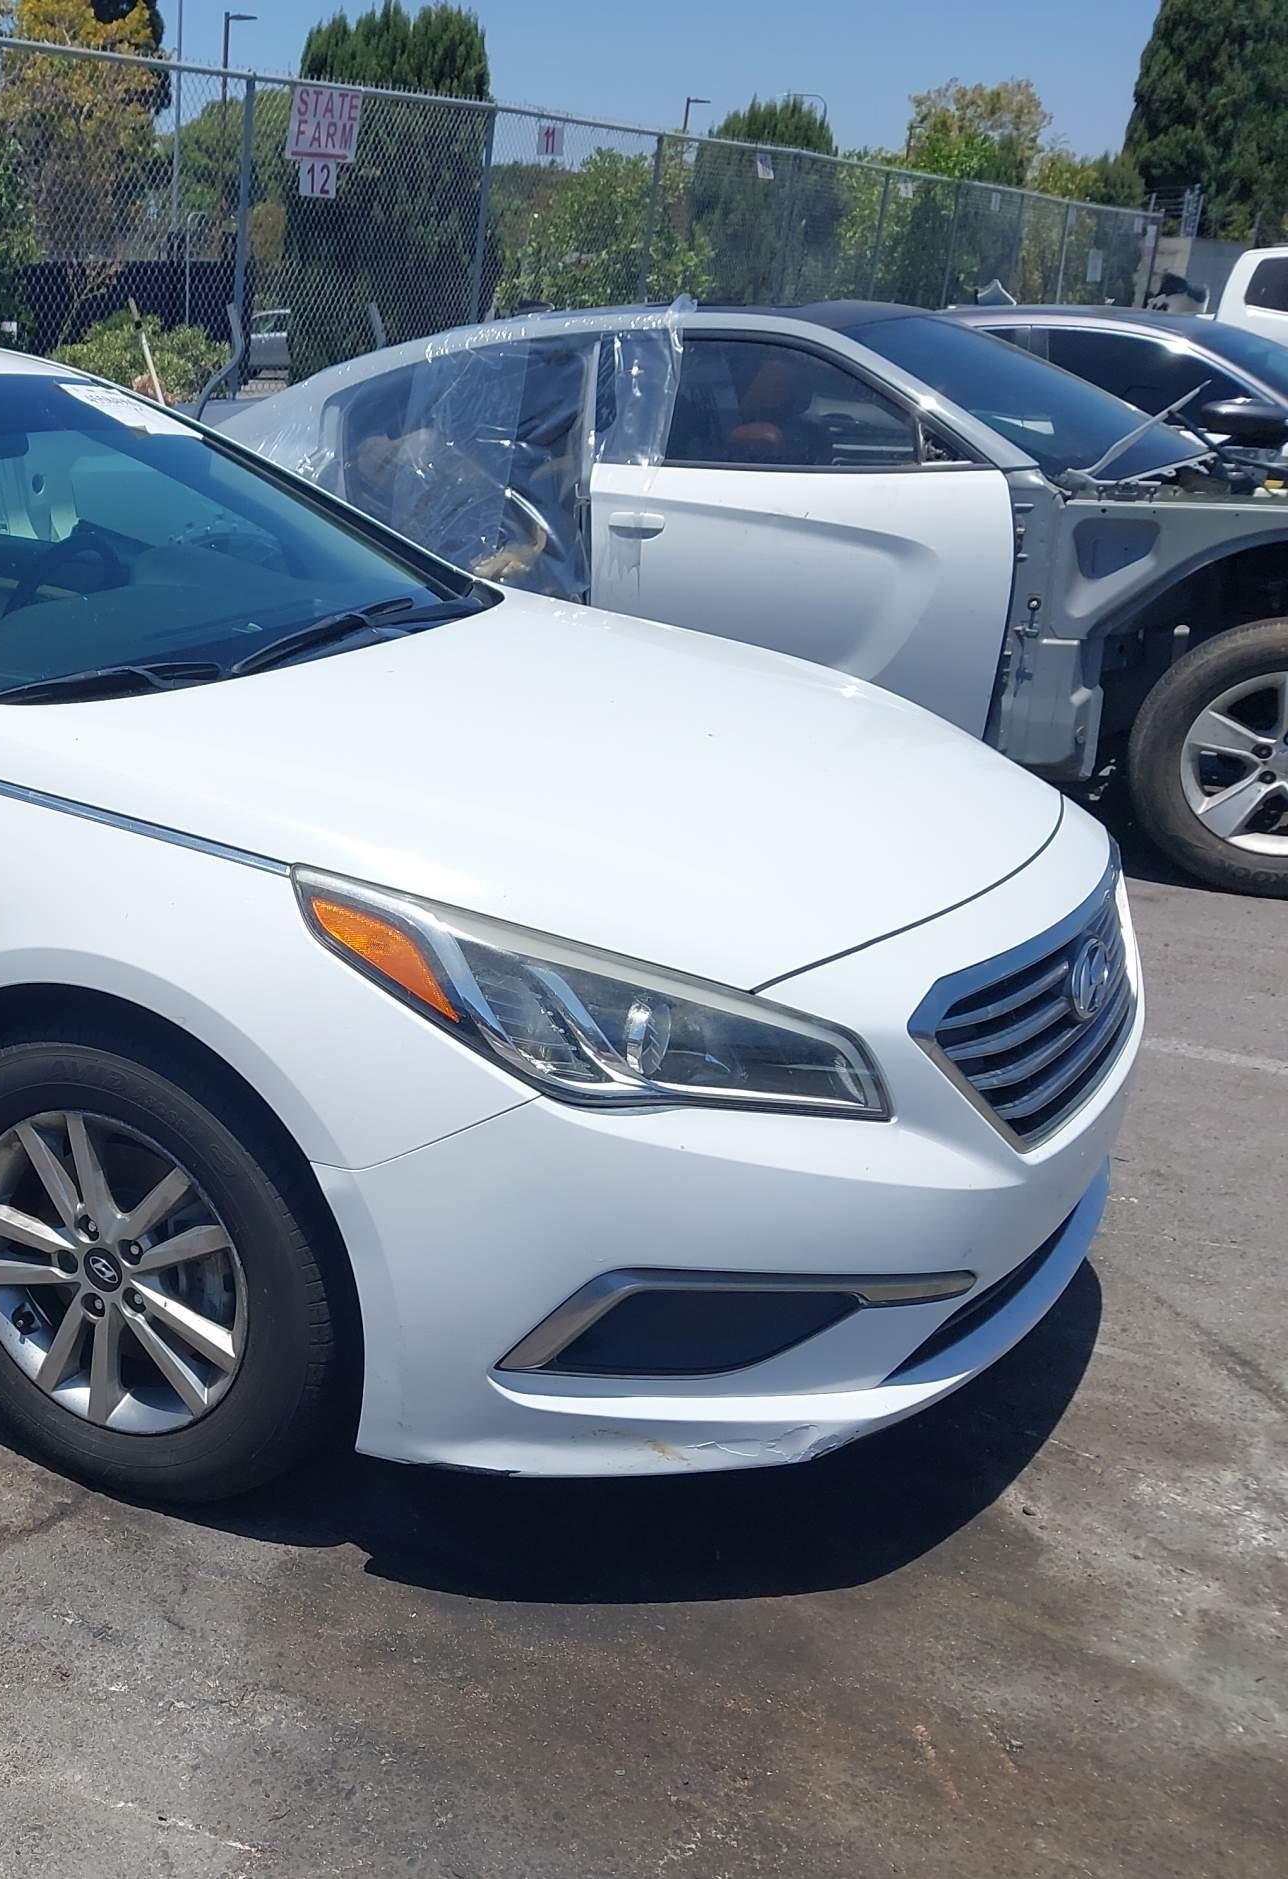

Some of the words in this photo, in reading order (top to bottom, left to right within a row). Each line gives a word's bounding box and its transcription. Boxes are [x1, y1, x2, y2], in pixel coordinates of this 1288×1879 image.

[297, 88, 361, 122] STATE
[295, 119, 354, 150] FARM
[307, 162, 331, 195] 12
